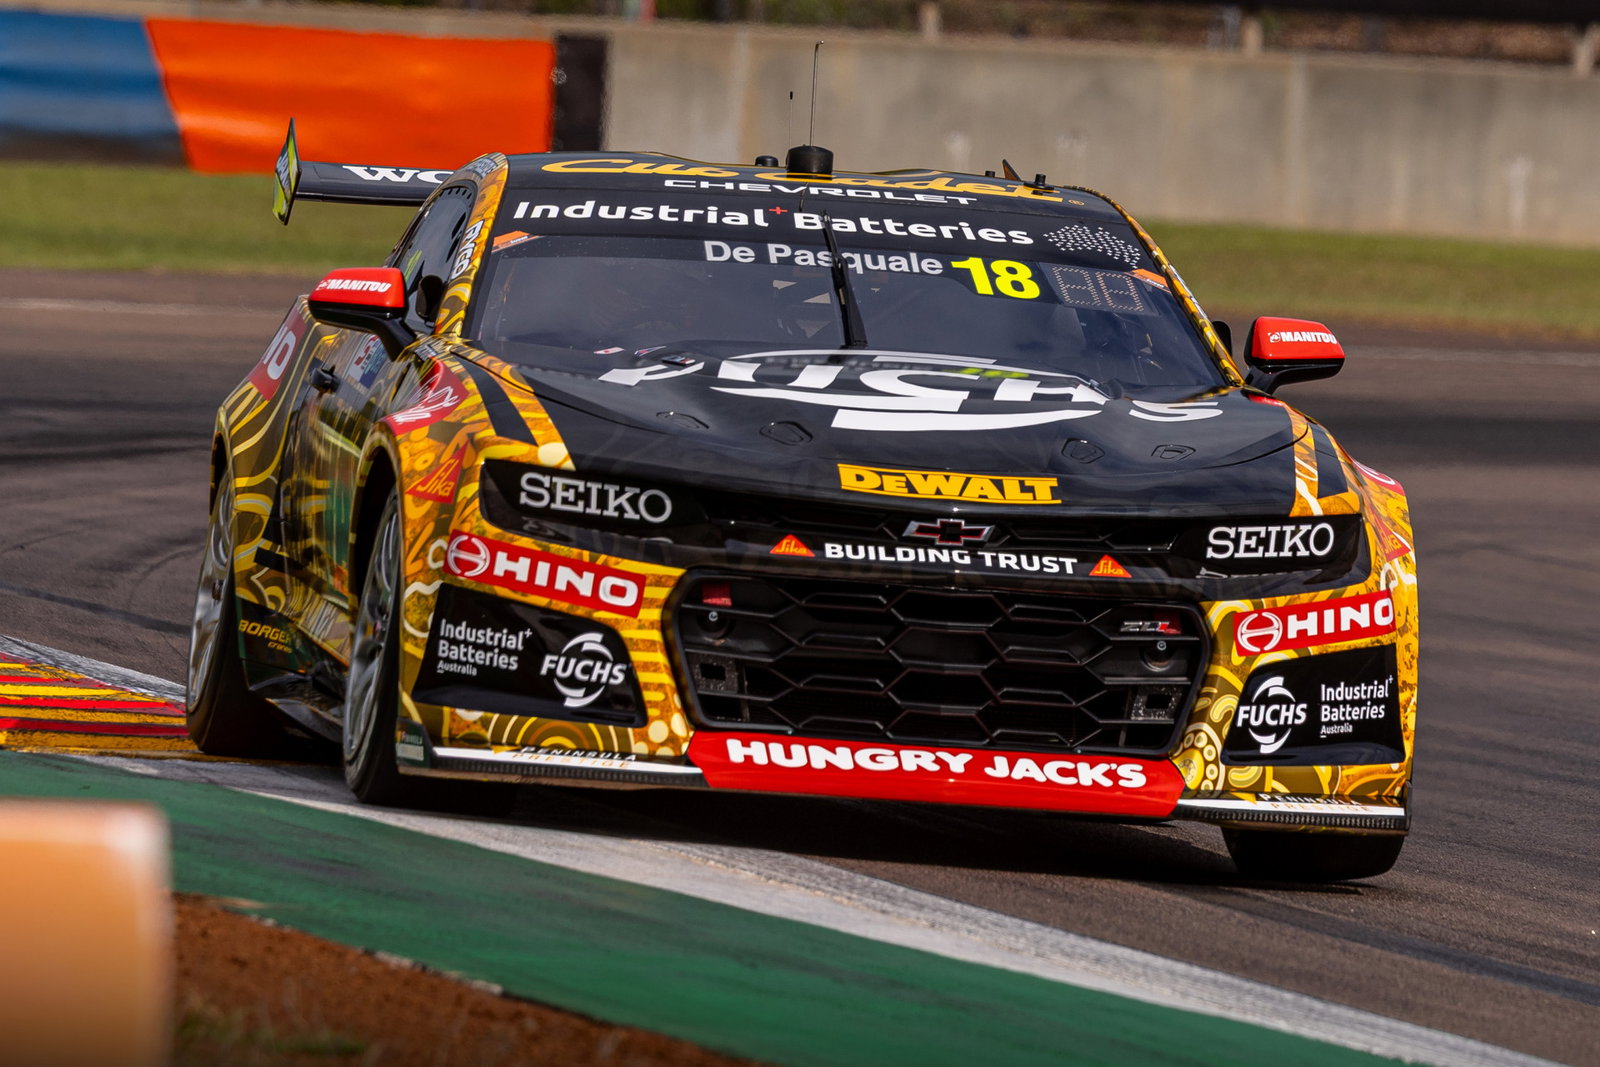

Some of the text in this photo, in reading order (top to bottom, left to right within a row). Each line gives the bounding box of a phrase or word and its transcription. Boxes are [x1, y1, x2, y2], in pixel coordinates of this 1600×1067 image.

[664, 179, 977, 205] CHEVROLET
[793, 211, 1034, 246] Batteries
[704, 240, 943, 276] De Pasquale
[326, 279, 392, 293] MANITOU
[951, 257, 1041, 299] 18
[1280, 331, 1337, 344] MANITOU
[519, 472, 673, 524] SEIKO
[776, 539, 807, 554] Sika
[1206, 522, 1335, 559] SEIKO
[824, 542, 1078, 574] BUILDING TRUST
[1094, 560, 1124, 575] Sika
[492, 550, 639, 608] HINO
[1287, 597, 1394, 640] HINO
[436, 660, 478, 677] Australia
[437, 640, 519, 671] Batteries
[540, 653, 626, 686] FUCHS
[1236, 703, 1308, 728] FUCHS
[1320, 701, 1386, 722] Batteries
[1319, 723, 1353, 738] Australia
[520, 746, 638, 761] PENINSULA
[726, 738, 1147, 788] HUNGRY JACK'S
